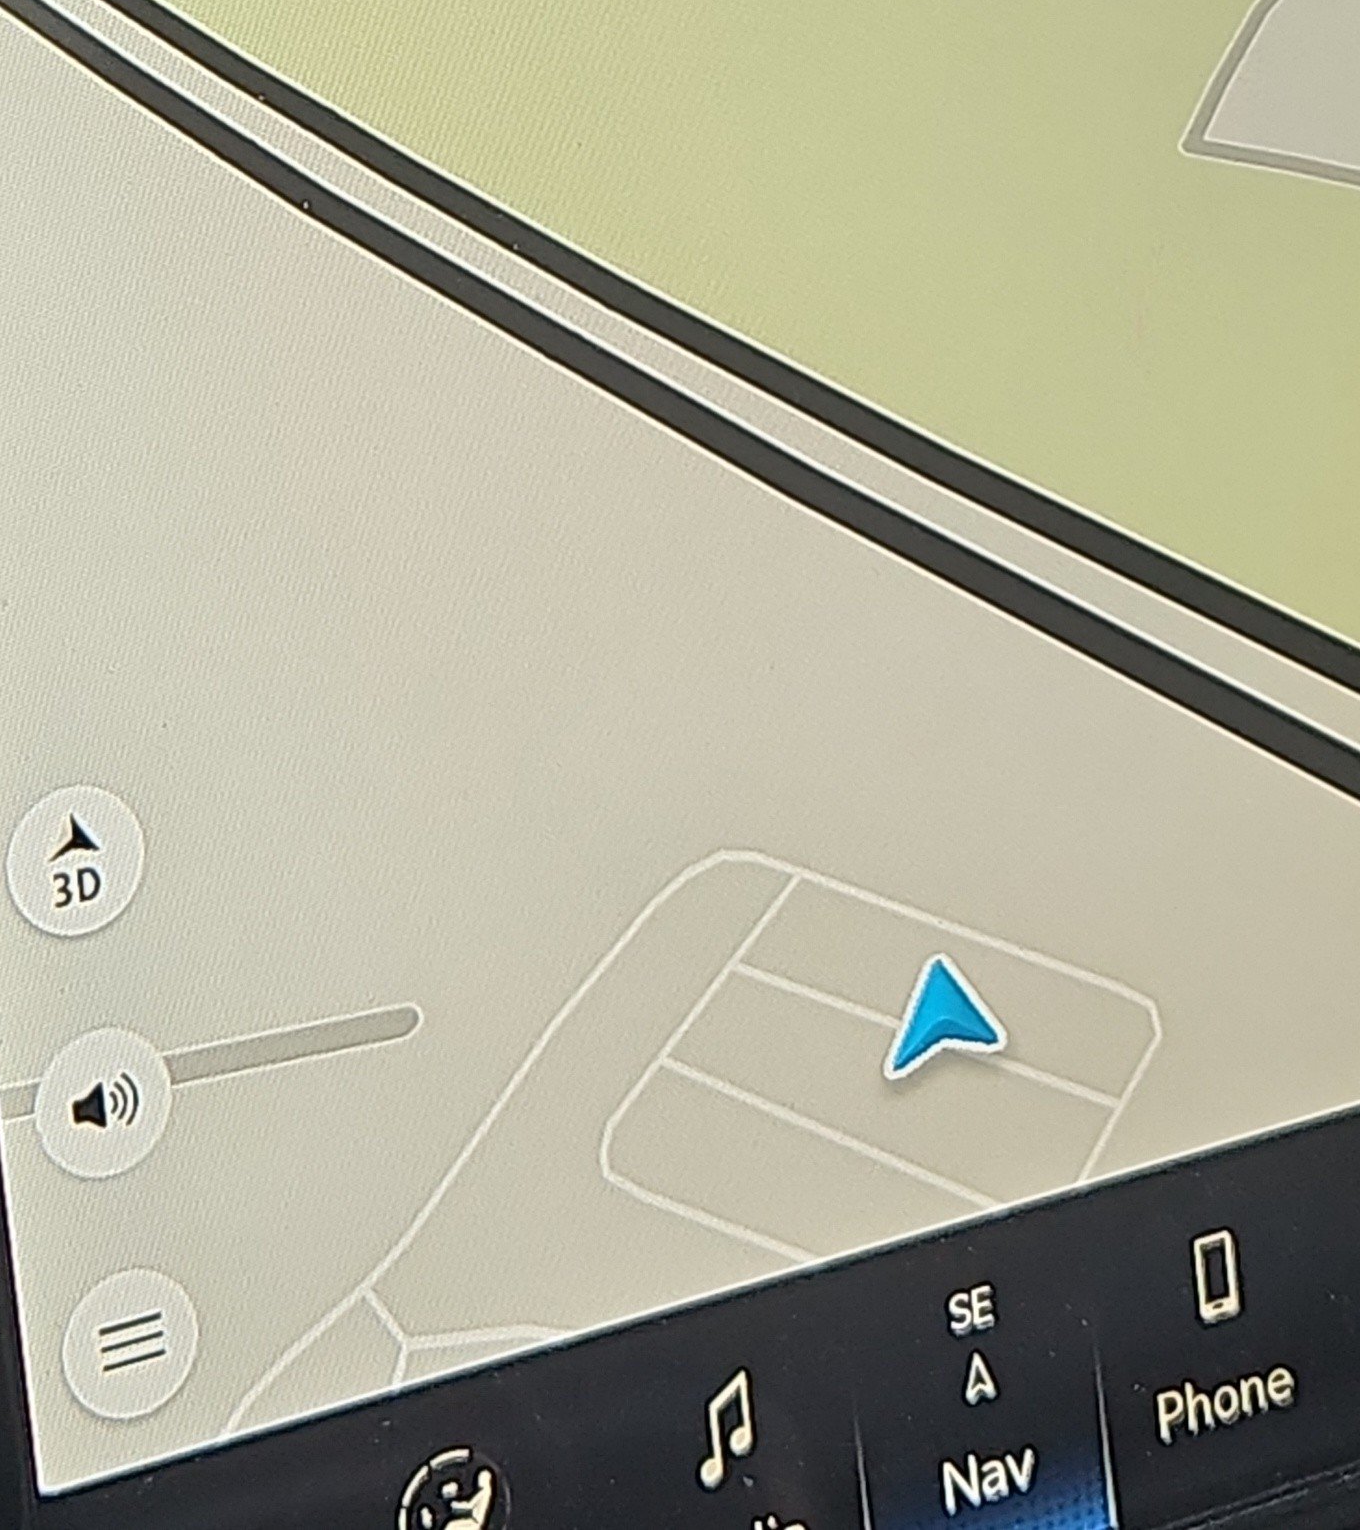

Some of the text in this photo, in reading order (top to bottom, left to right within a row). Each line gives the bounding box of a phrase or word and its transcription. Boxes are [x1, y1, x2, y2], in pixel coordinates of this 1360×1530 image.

[51, 868, 101, 908] 3D
[948, 1285, 996, 1336] SE
[1156, 1364, 1295, 1445] Phone
[941, 1448, 1035, 1515] Nav
